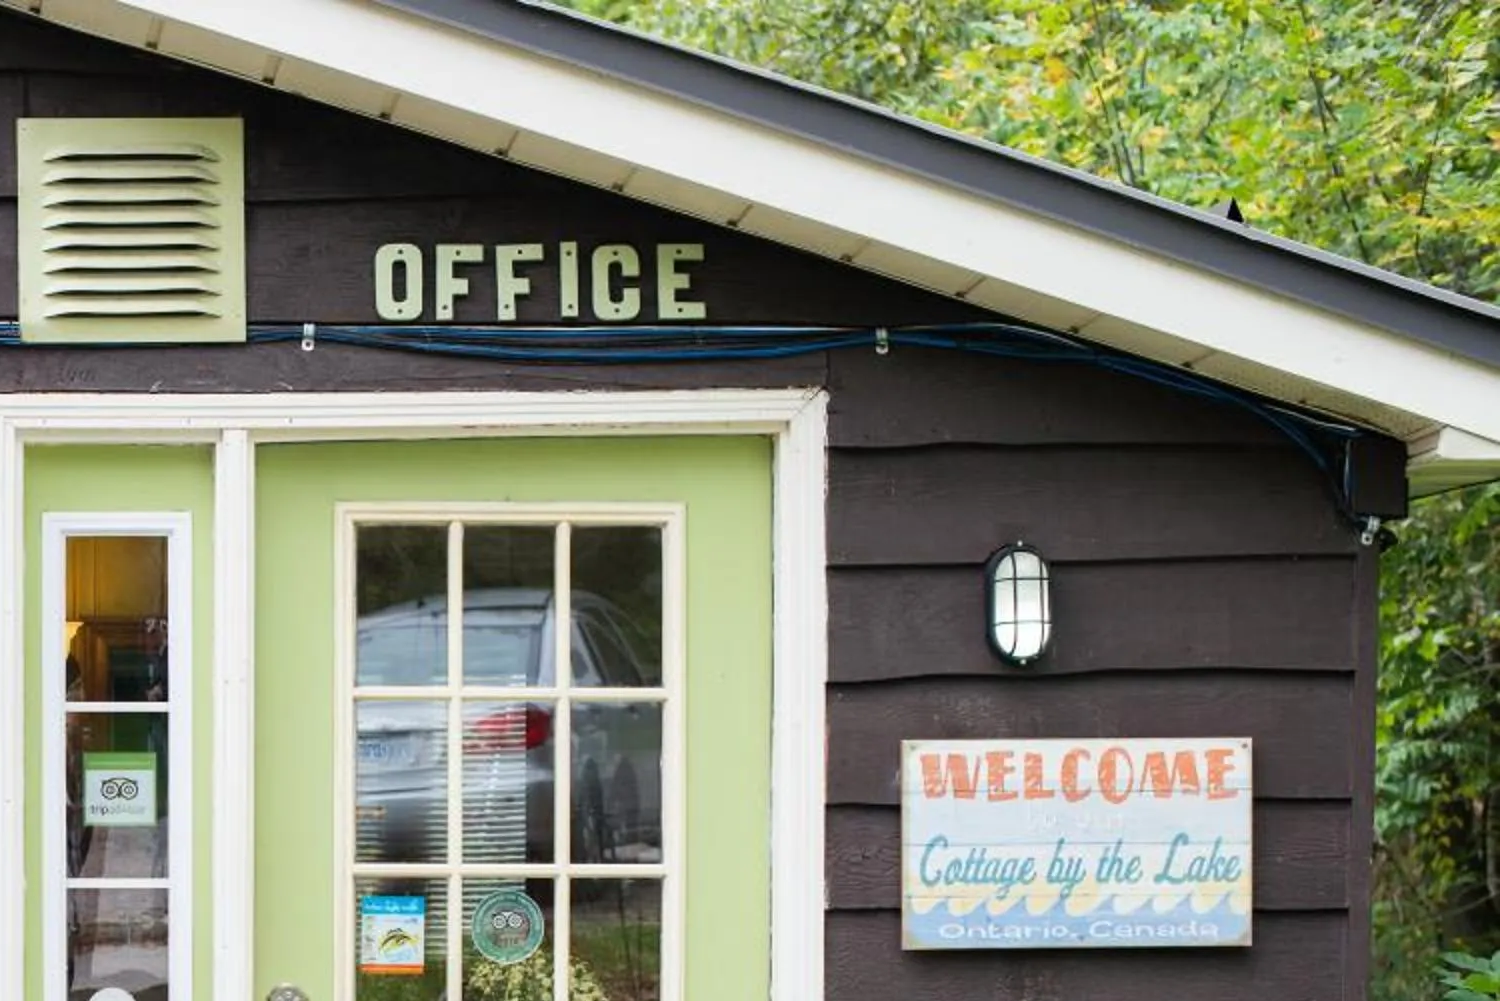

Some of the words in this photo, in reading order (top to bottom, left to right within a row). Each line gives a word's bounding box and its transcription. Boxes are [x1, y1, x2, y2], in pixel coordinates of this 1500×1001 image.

[375, 241, 707, 321] OFFICE
[920, 746, 1239, 804] WELCOME
[920, 834, 1037, 899] Cottage
[1046, 837, 1087, 899] by
[1095, 838, 1143, 884] the
[1153, 832, 1243, 885] Lake
[1088, 919, 1220, 940] Canada
